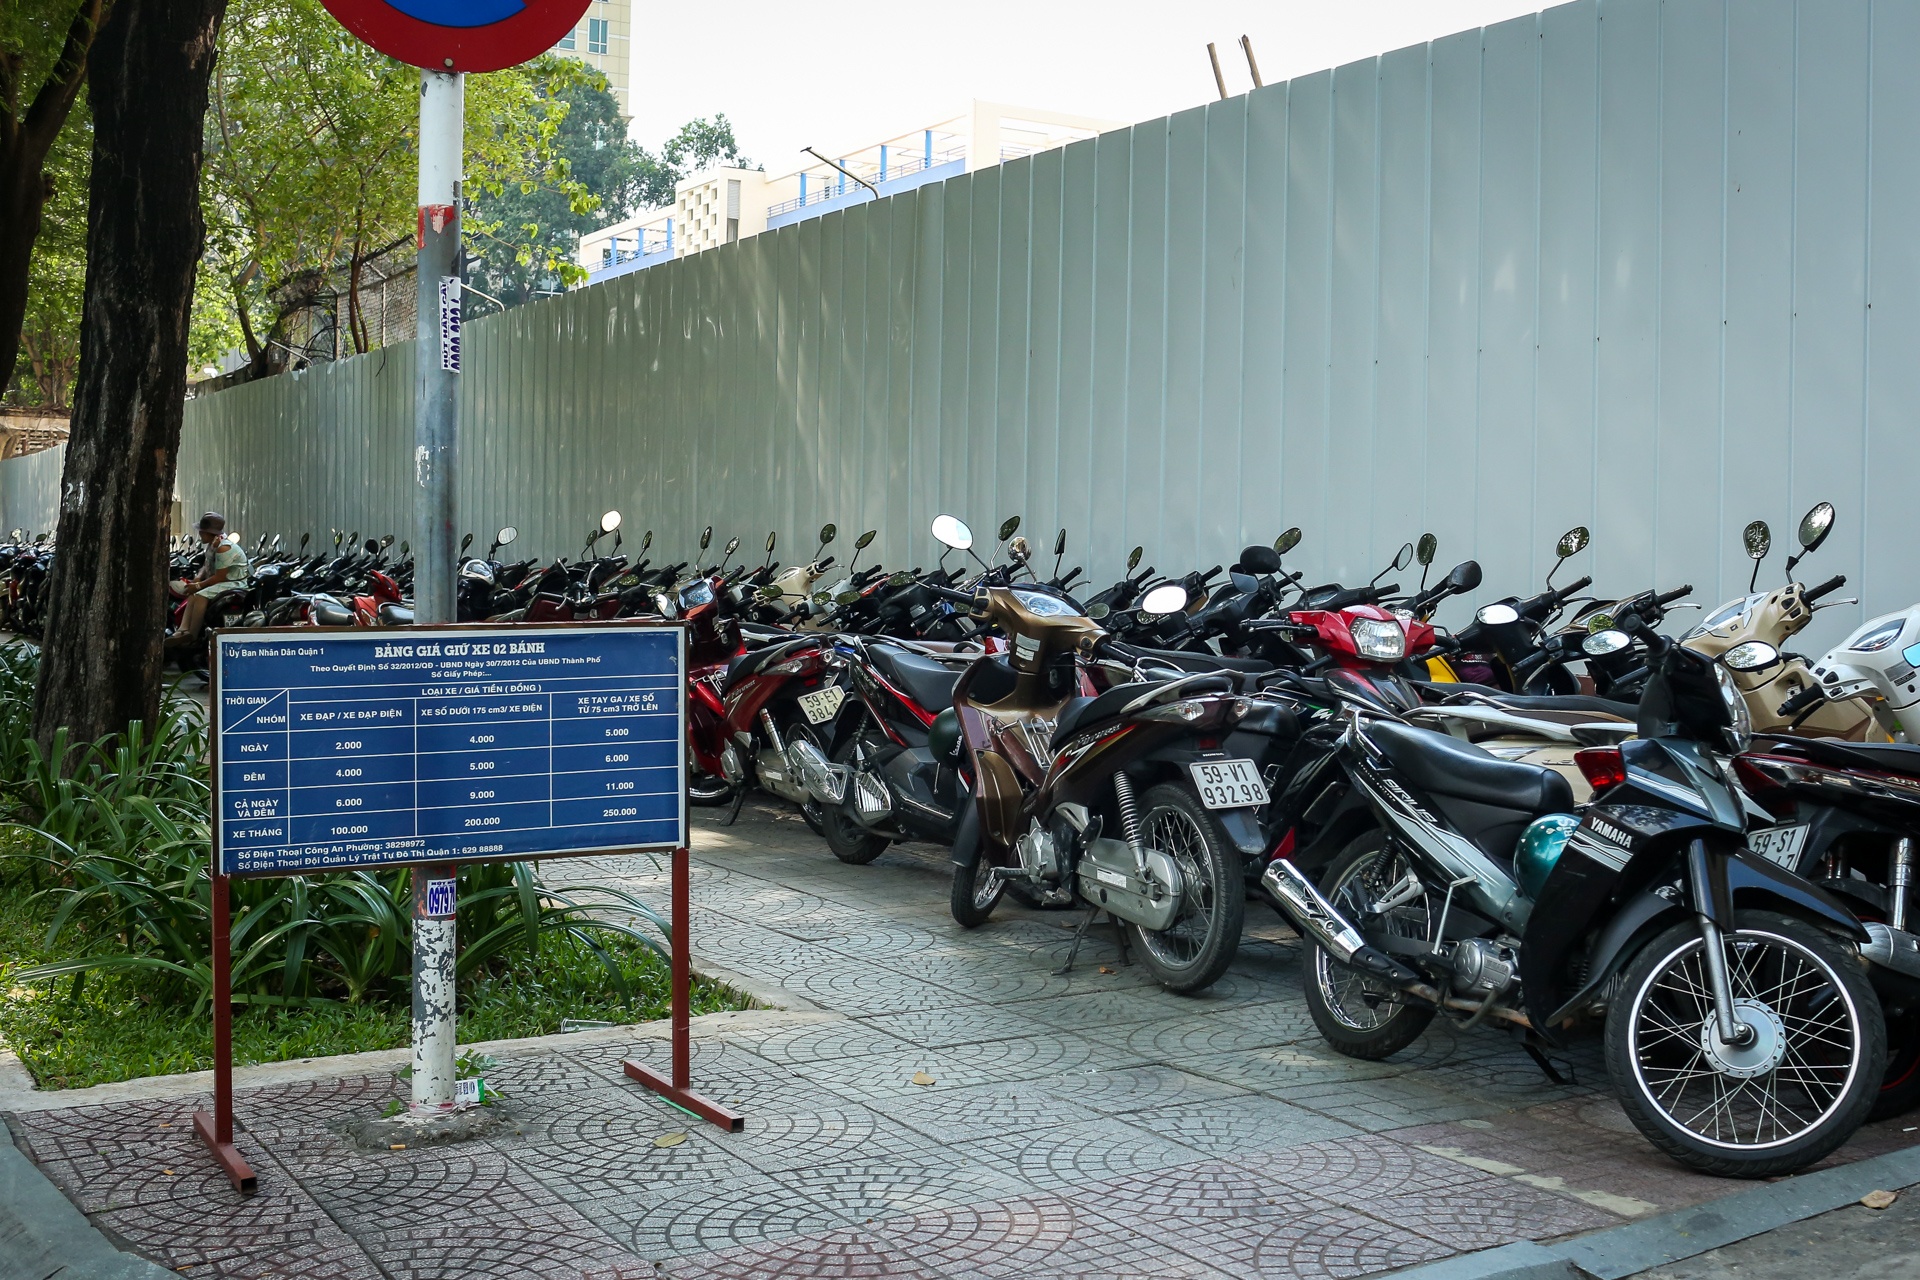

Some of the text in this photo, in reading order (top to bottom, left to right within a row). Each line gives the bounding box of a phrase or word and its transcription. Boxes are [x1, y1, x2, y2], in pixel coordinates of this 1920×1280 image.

[242, 649, 257, 657] Ban
[258, 648, 279, 657] Nhân
[280, 648, 296, 656] Dân
[297, 648, 318, 657] Quận
[374, 639, 546, 658] BẢNG GIÁ GIỮ XE 02 BÁNH
[310, 665, 331, 673] Theo
[332, 663, 356, 673] Quyết
[358, 663, 376, 673] Định
[378, 662, 389, 671] Số
[390, 661, 434, 671] 32/2012/QĐ
[440, 661, 463, 669] UBND
[465, 660, 485, 669] Ngày
[485, 659, 521, 668] 30/7/2012
[522, 658, 537, 667] Của
[538, 658, 560, 666] UBND
[561, 656, 585, 665] Thành
[586, 655, 602, 664] Phố
[431, 671, 443, 679] Số
[443, 669, 461, 680] Giấy
[421, 688, 443, 698] LOẠI
[445, 687, 458, 695] XE
[464, 684, 481, 695] GIÁ
[482, 682, 504, 694] TIỀN
[578, 697, 590, 705] XE
[591, 695, 608, 704] TAY
[610, 695, 623, 703] GA
[629, 694, 640, 702] XE
[642, 692, 655, 702] SỐ
[805, 689, 839, 708] 59-E1
[225, 696, 267, 706] THỜI GIAN
[421, 708, 433, 716] XE
[434, 706, 448, 716] SỐ
[449, 704, 471, 715] DƯỚI
[472, 706, 487, 714] 175
[509, 704, 521, 713] XE
[522, 702, 543, 713] ĐIỆN
[578, 705, 590, 714] TỪ
[603, 705, 620, 713] cm3
[622, 702, 640, 712] TRỞ
[641, 702, 659, 711] LÊN
[256, 714, 286, 724] NHÓM
[300, 712, 314, 721] XE
[315, 711, 335, 722] ĐẠP
[343, 711, 356, 719] XE
[358, 710, 378, 720] ĐẠP
[379, 708, 403, 719] ĐIỆN
[240, 728, 629, 753] NGÀY 2.000 4.000 5.000
[243, 753, 629, 782] ĐÊM 4.000 5.000 6.000
[1200, 764, 1249, 784] 59-V1
[234, 781, 634, 809] CẢ NGÀY 6.000 9.000 11.000
[1203, 783, 1264, 806] 932.98
[237, 807, 276, 818] VÀ ĐÊM
[232, 807, 637, 839] XE THÁNG 100.000 200.000 250.000
[1589, 816, 1633, 849] YAMAHA
[238, 850, 251, 859] Số
[252, 850, 274, 858] Điện
[276, 848, 303, 857] Thoại
[304, 846, 329, 855] Công
[345, 843, 383, 852] Phường:
[385, 840, 426, 849] 38298972
[1753, 828, 1797, 856] 59-S1
[238, 860, 251, 870] Số
[252, 860, 275, 869] Điện
[276, 858, 303, 868] Thoại
[304, 857, 320, 867] Đội
[322, 855, 347, 864] Quản
[348, 854, 360, 863] Lý
[361, 853, 381, 862] Trật
[382, 851, 395, 861] Tự
[396, 850, 409, 859] Đô
[410, 849, 426, 858] Thị
[426, 848, 450, 857] Quận
[451, 847, 460, 856] 1:
